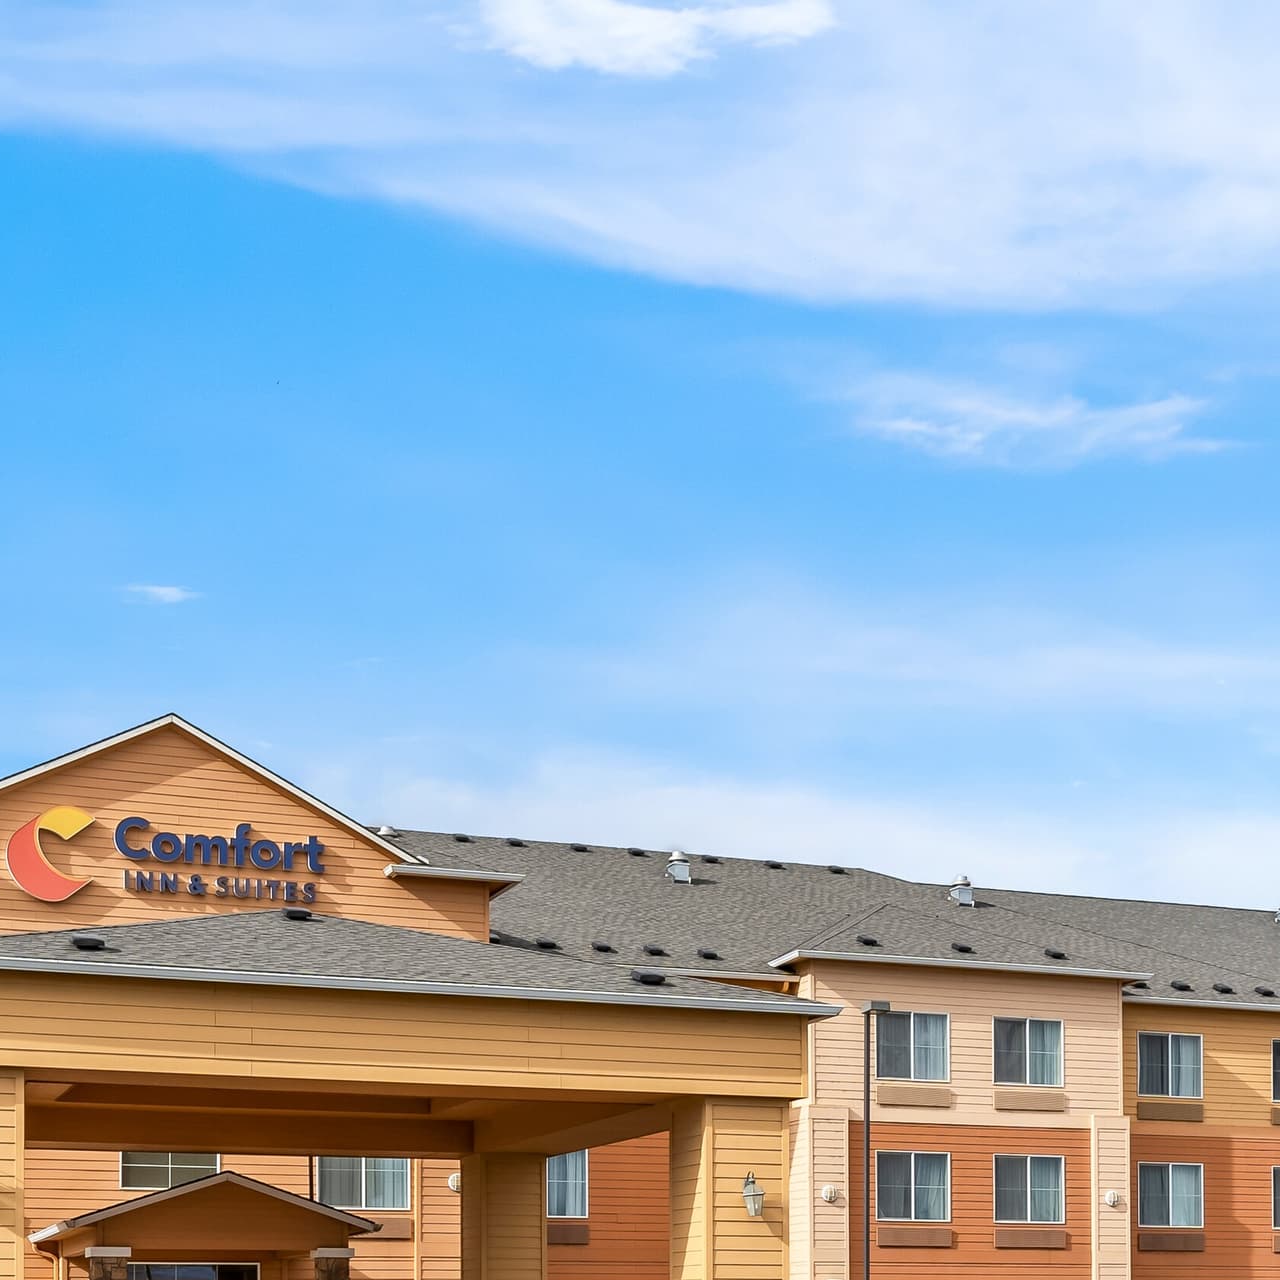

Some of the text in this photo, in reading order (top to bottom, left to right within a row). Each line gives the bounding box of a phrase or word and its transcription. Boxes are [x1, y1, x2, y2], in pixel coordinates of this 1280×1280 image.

[113, 816, 326, 874] Comfort
[123, 869, 317, 903] INN & SUITES
